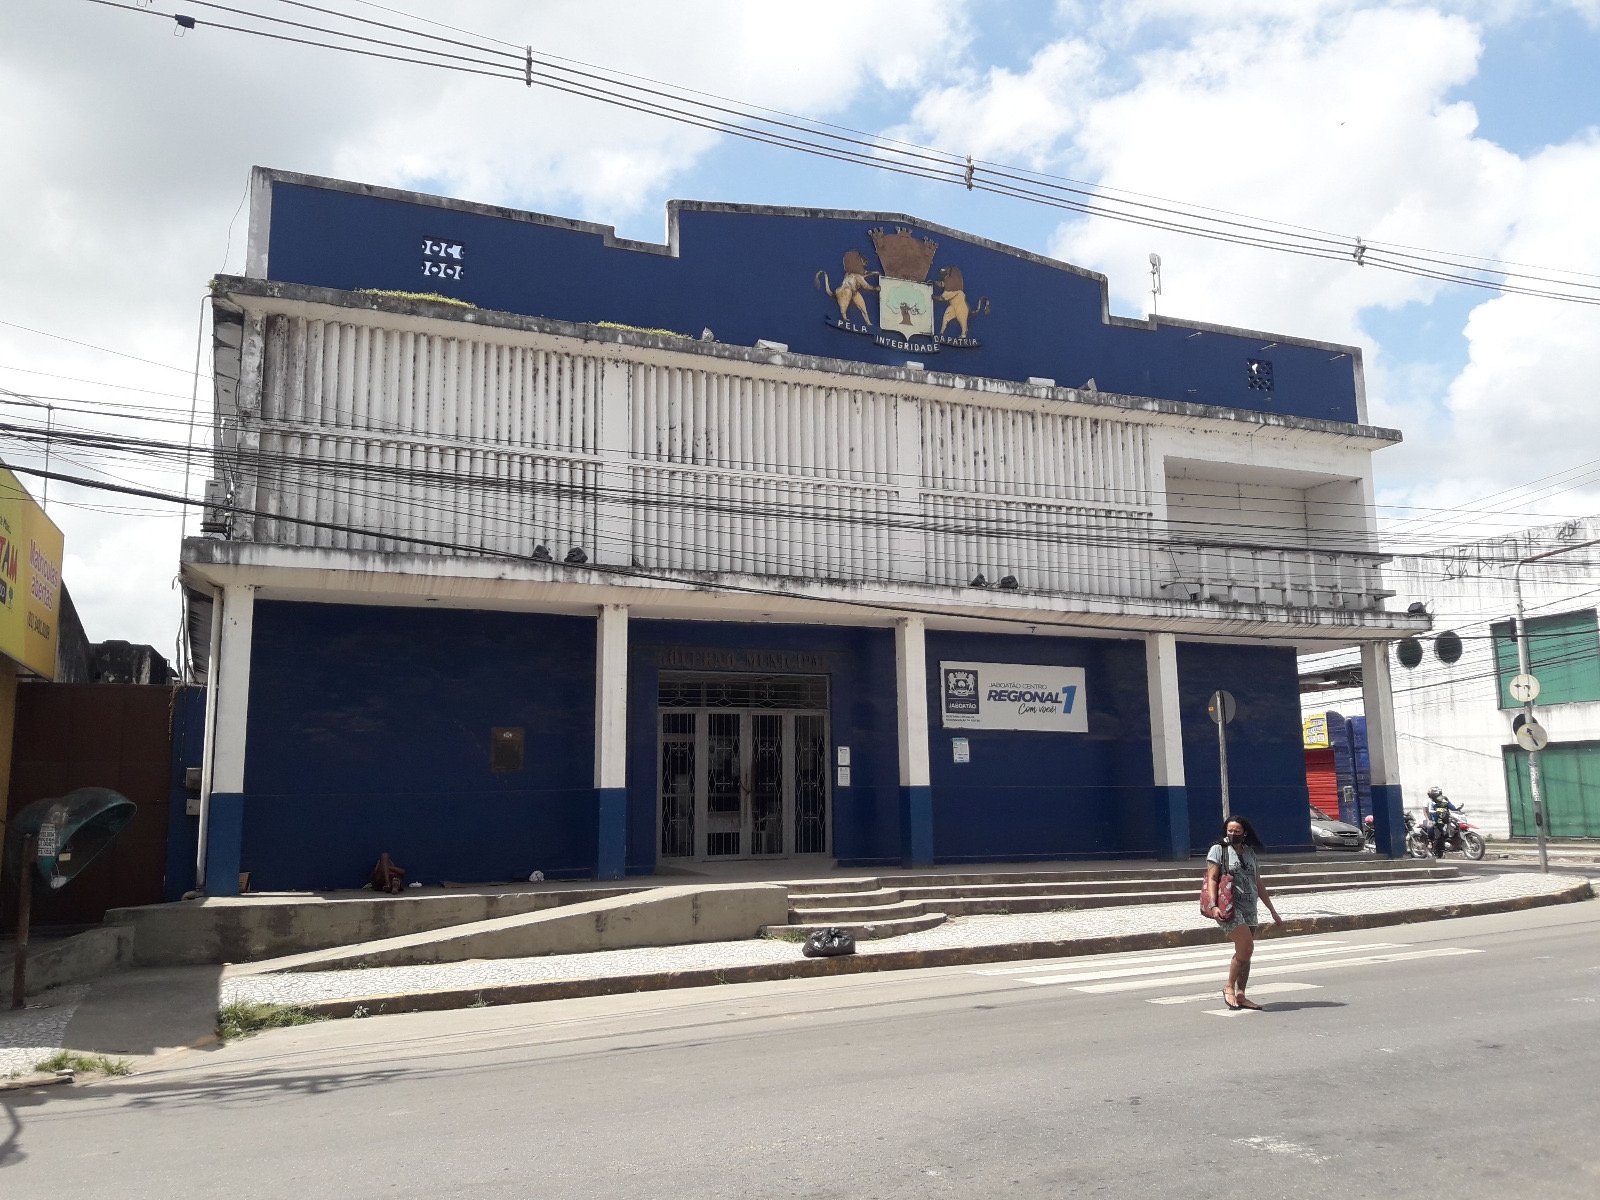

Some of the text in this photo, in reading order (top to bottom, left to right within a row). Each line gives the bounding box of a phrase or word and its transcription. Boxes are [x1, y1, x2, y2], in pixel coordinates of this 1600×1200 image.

[838, 320, 868, 333] PELA
[876, 334, 940, 352] INTEGRIDADE
[934, 335, 978, 346] DA PATRIA
[987, 685, 1077, 714] REGIONAL 1
[1018, 702, 1037, 715] Com
